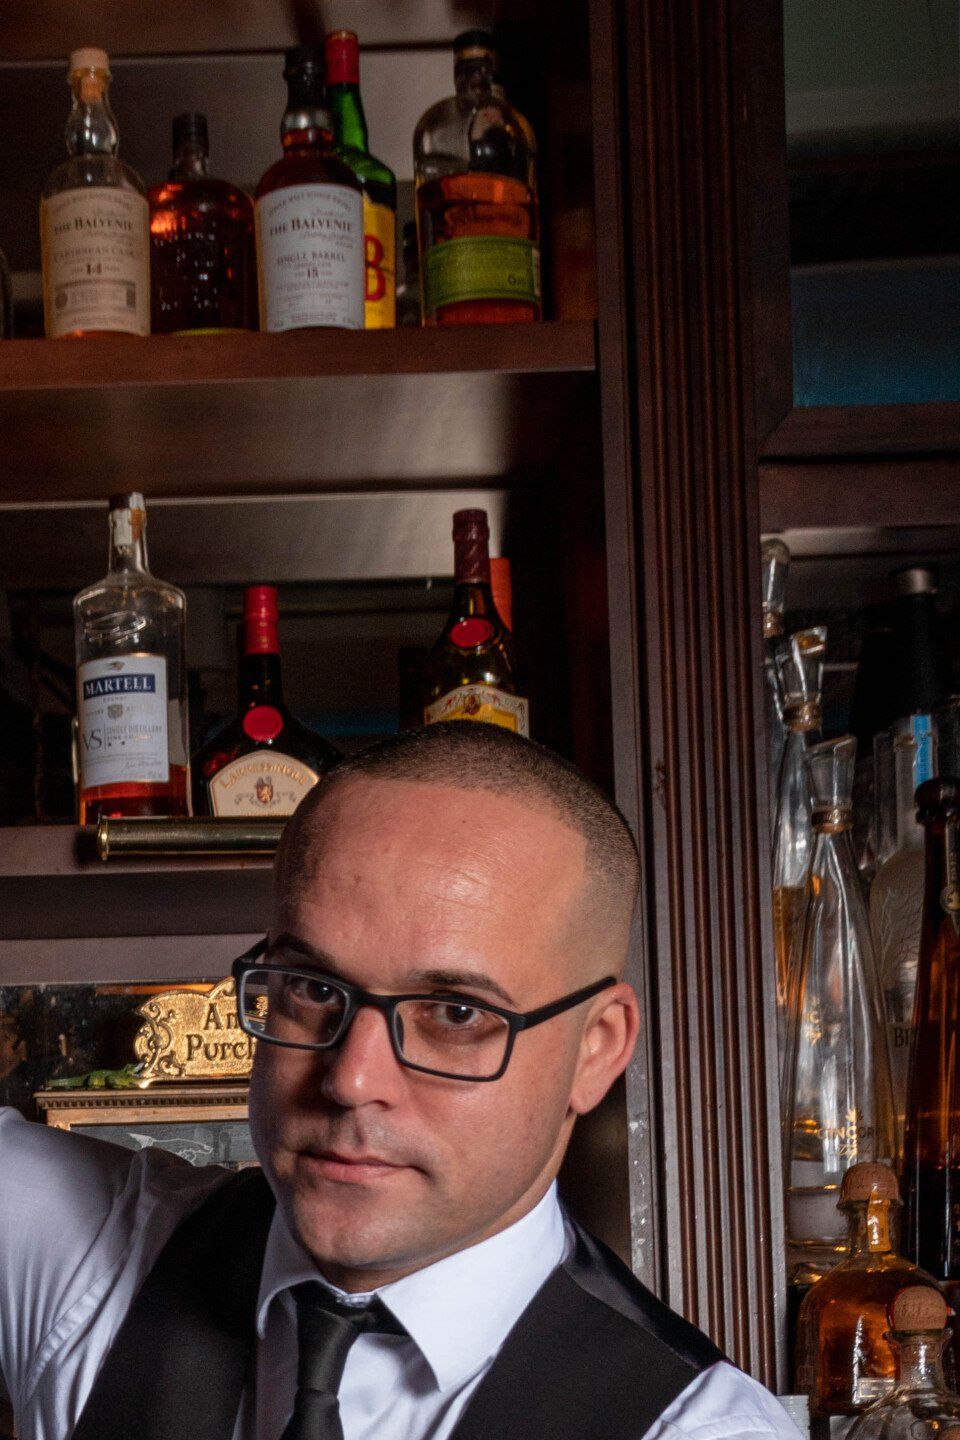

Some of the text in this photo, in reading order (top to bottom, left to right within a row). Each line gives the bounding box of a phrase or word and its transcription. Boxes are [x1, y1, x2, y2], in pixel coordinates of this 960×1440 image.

[74, 217, 133, 231] BALVENIE
[269, 217, 352, 237] THE BALVENIE
[311, 251, 346, 262] BARREL
[306, 268, 319, 279] 15
[85, 676, 153, 696] MARTELL
